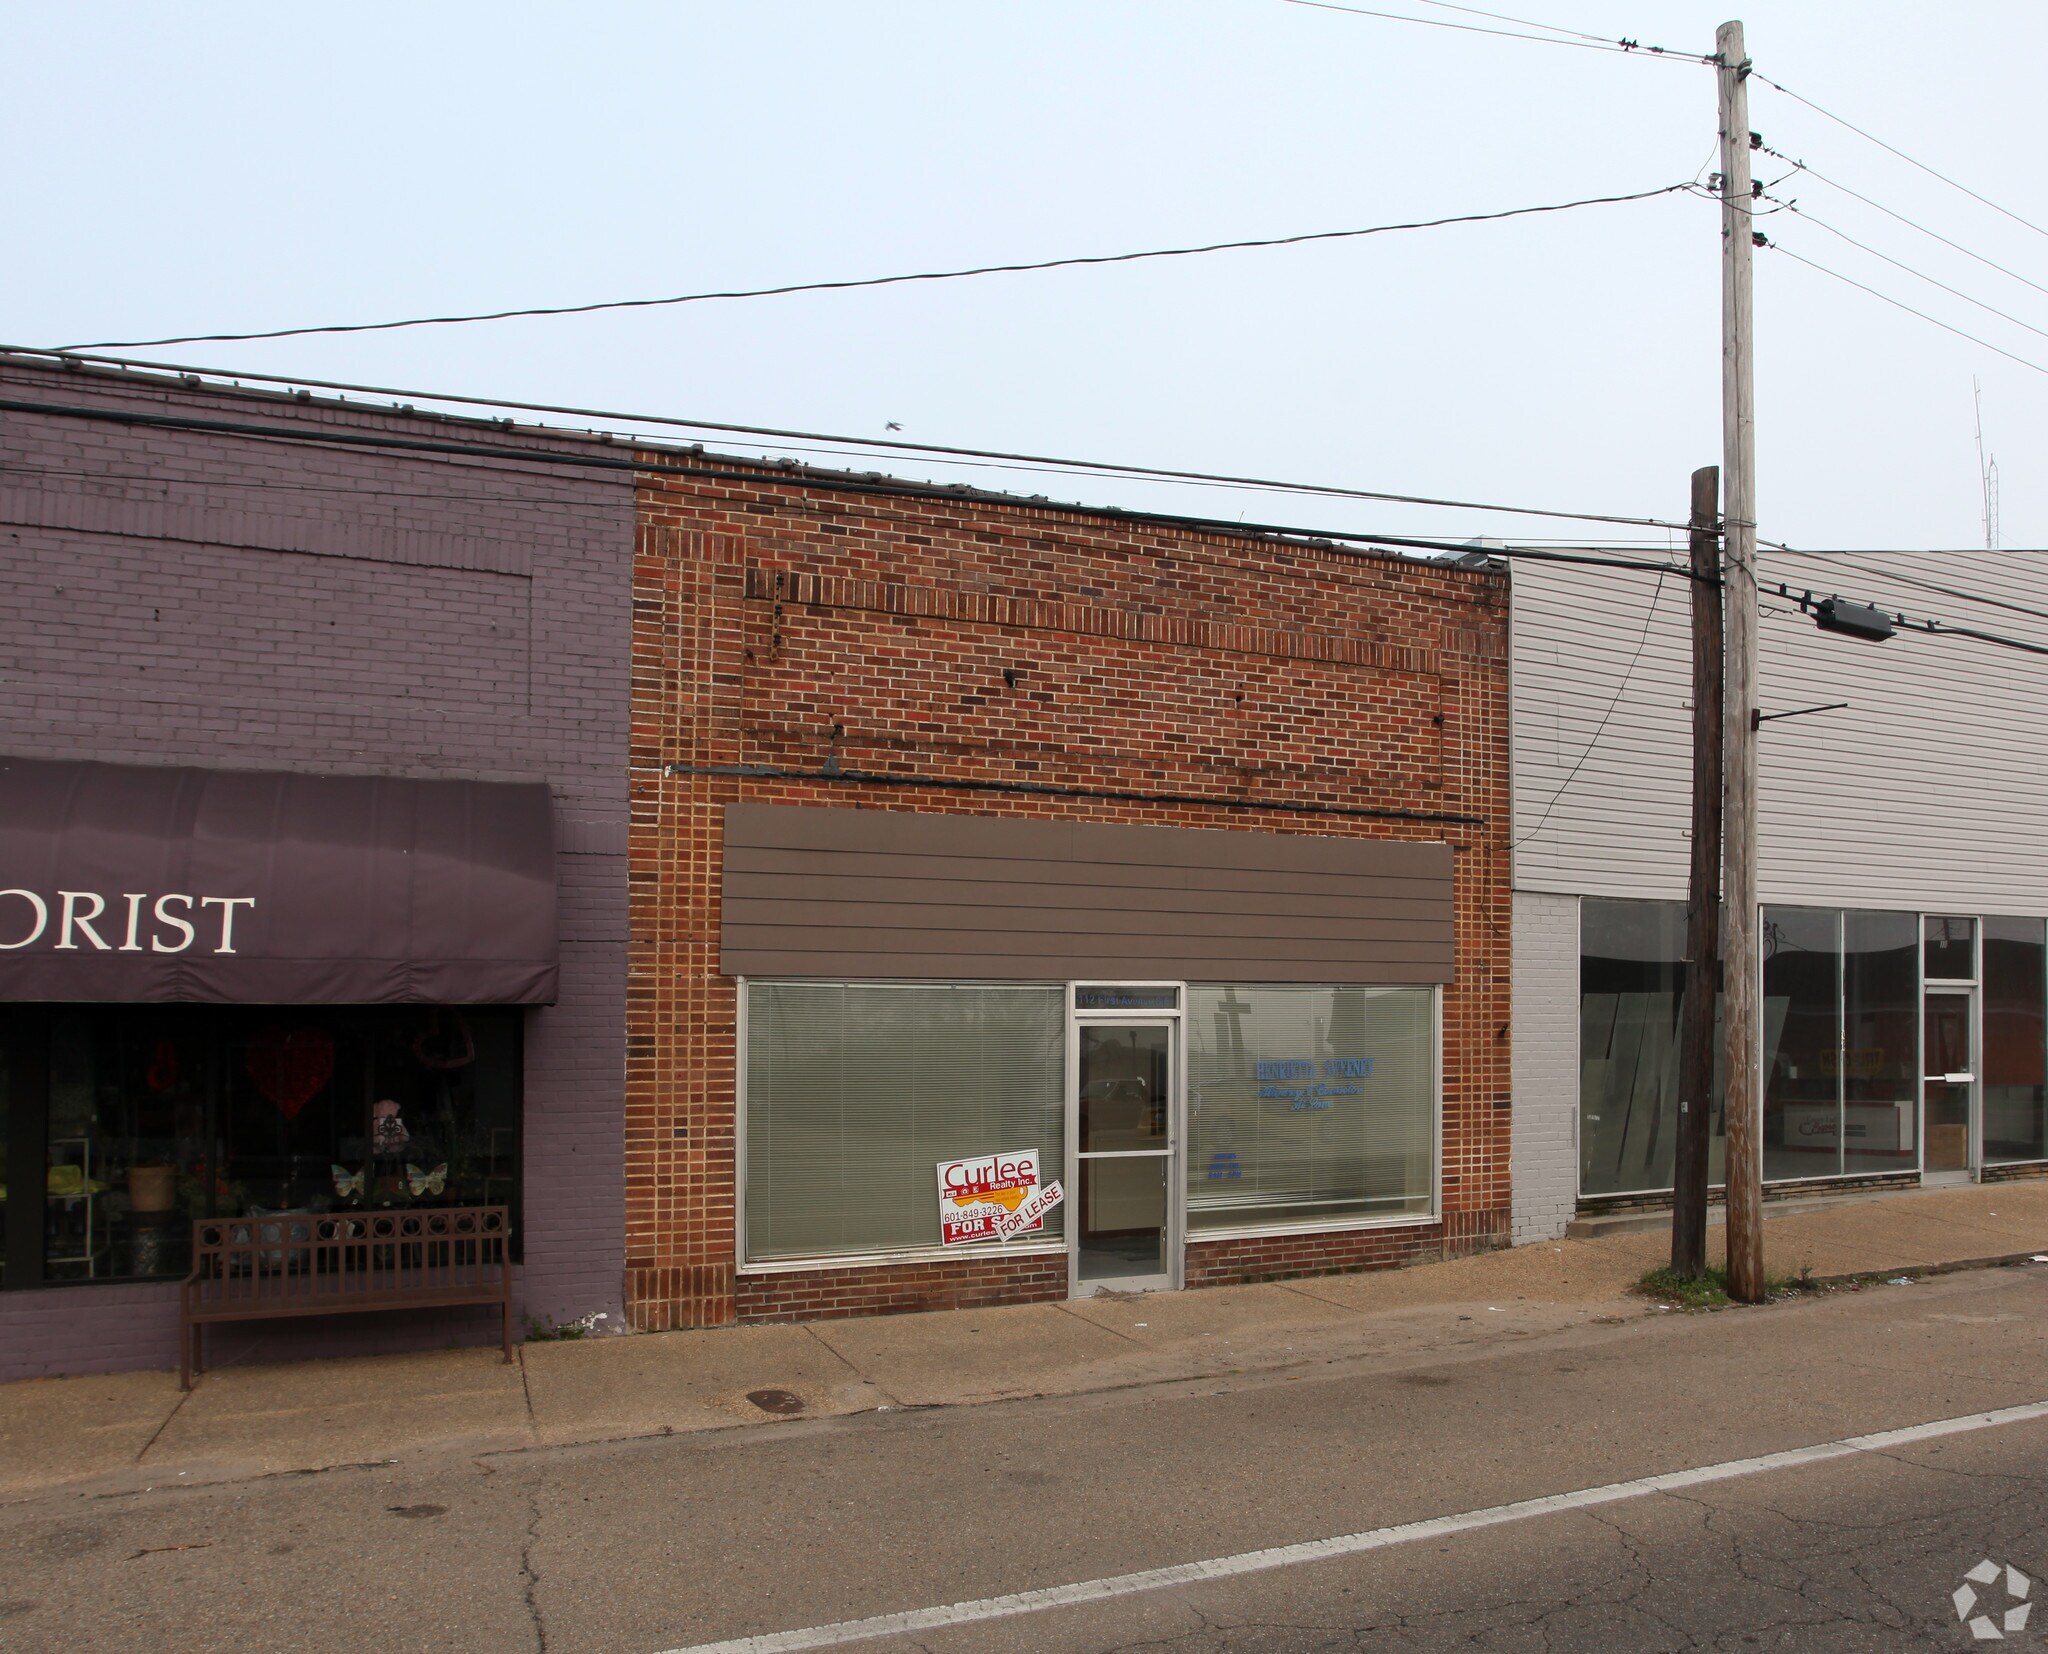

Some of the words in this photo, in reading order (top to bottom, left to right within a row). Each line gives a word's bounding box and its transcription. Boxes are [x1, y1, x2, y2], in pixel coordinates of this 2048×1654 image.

[0, 888, 255, 953] ORIST
[945, 1157, 1034, 1188] Curlee
[989, 1180, 1016, 1191] Realty
[1018, 1178, 1033, 1186] Inc.
[944, 1205, 1003, 1222] 601-849-3226
[1000, 1214, 1025, 1236] FOR
[1025, 1186, 1061, 1219] LEASE
[950, 1219, 985, 1236] FOR
